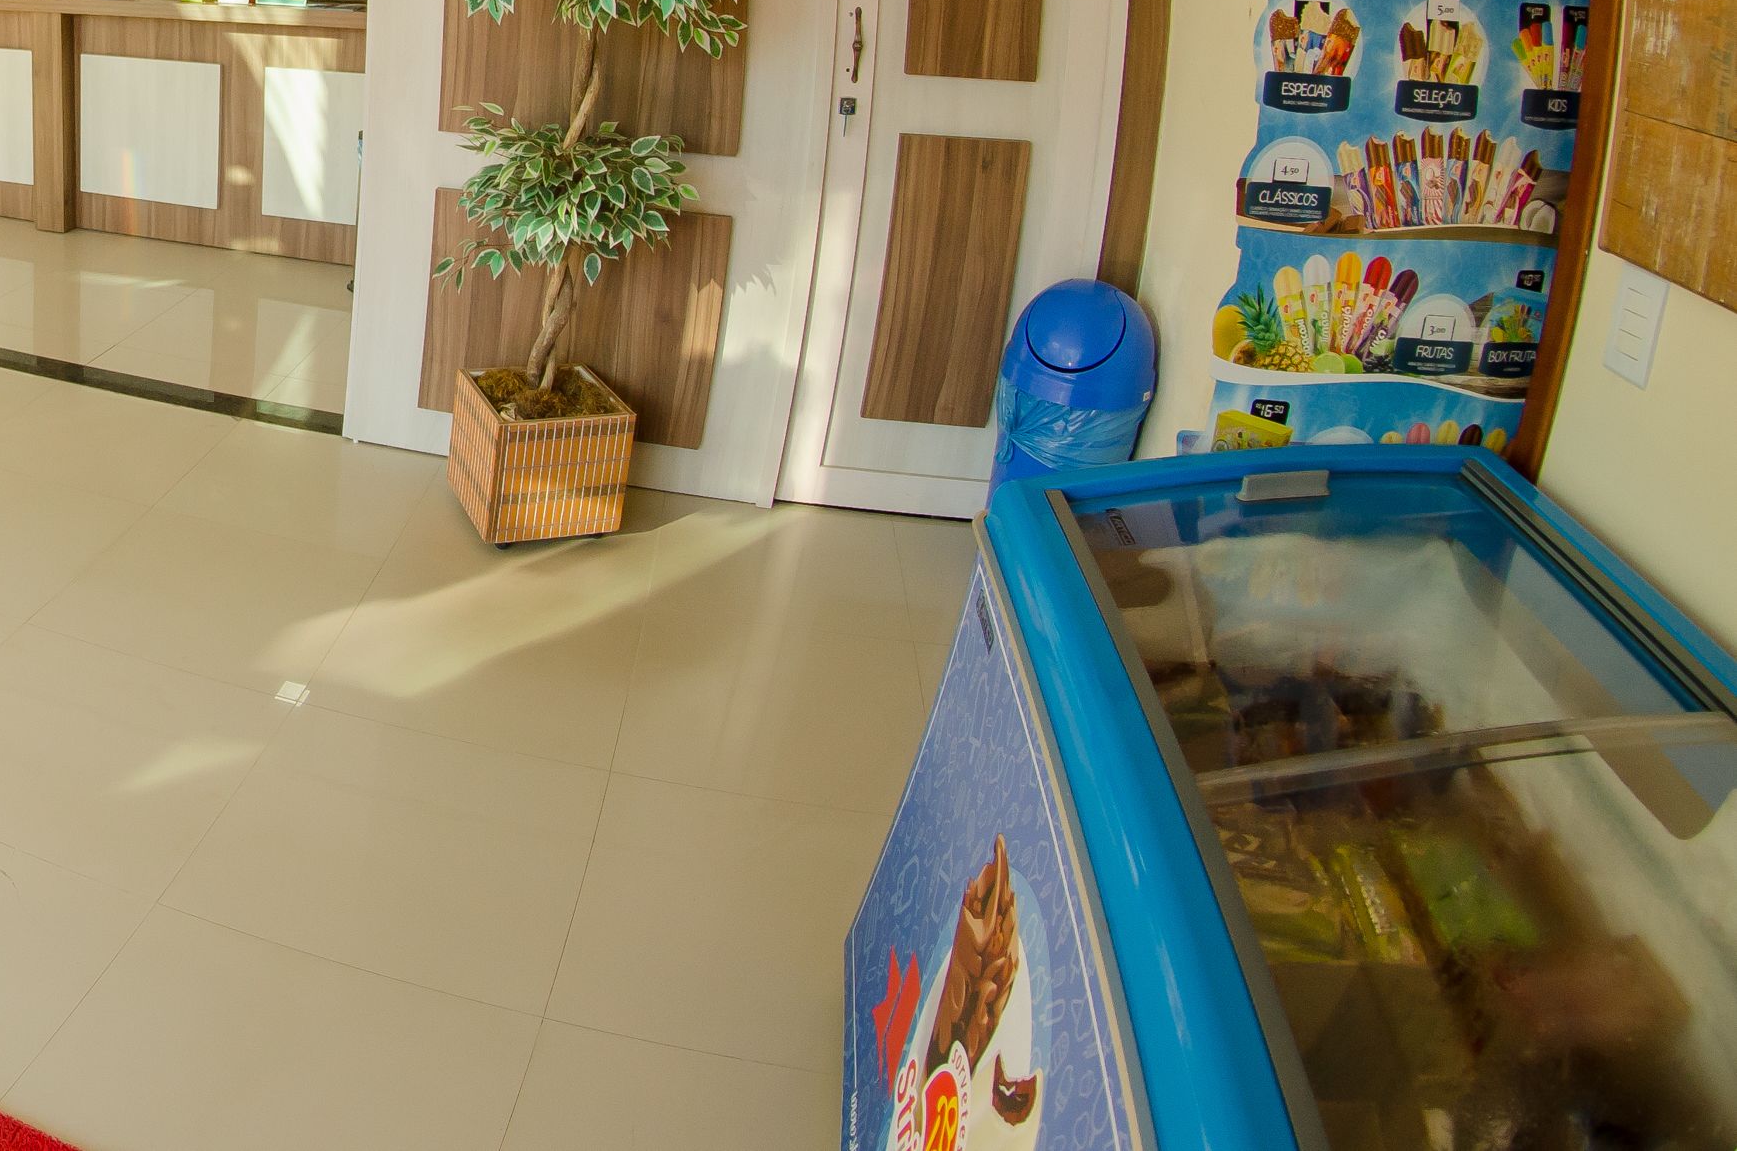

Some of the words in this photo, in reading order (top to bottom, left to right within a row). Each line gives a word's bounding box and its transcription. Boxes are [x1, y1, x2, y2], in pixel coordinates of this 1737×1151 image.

[1281, 81, 1333, 98] ESPECIAIS
[1413, 88, 1462, 108] SELEÇÃO
[1548, 99, 1568, 113] KIDS
[1258, 188, 1318, 207] CLÁSSICOS
[1415, 345, 1455, 360] FRUTAS
[1487, 350, 1508, 363] BOX
